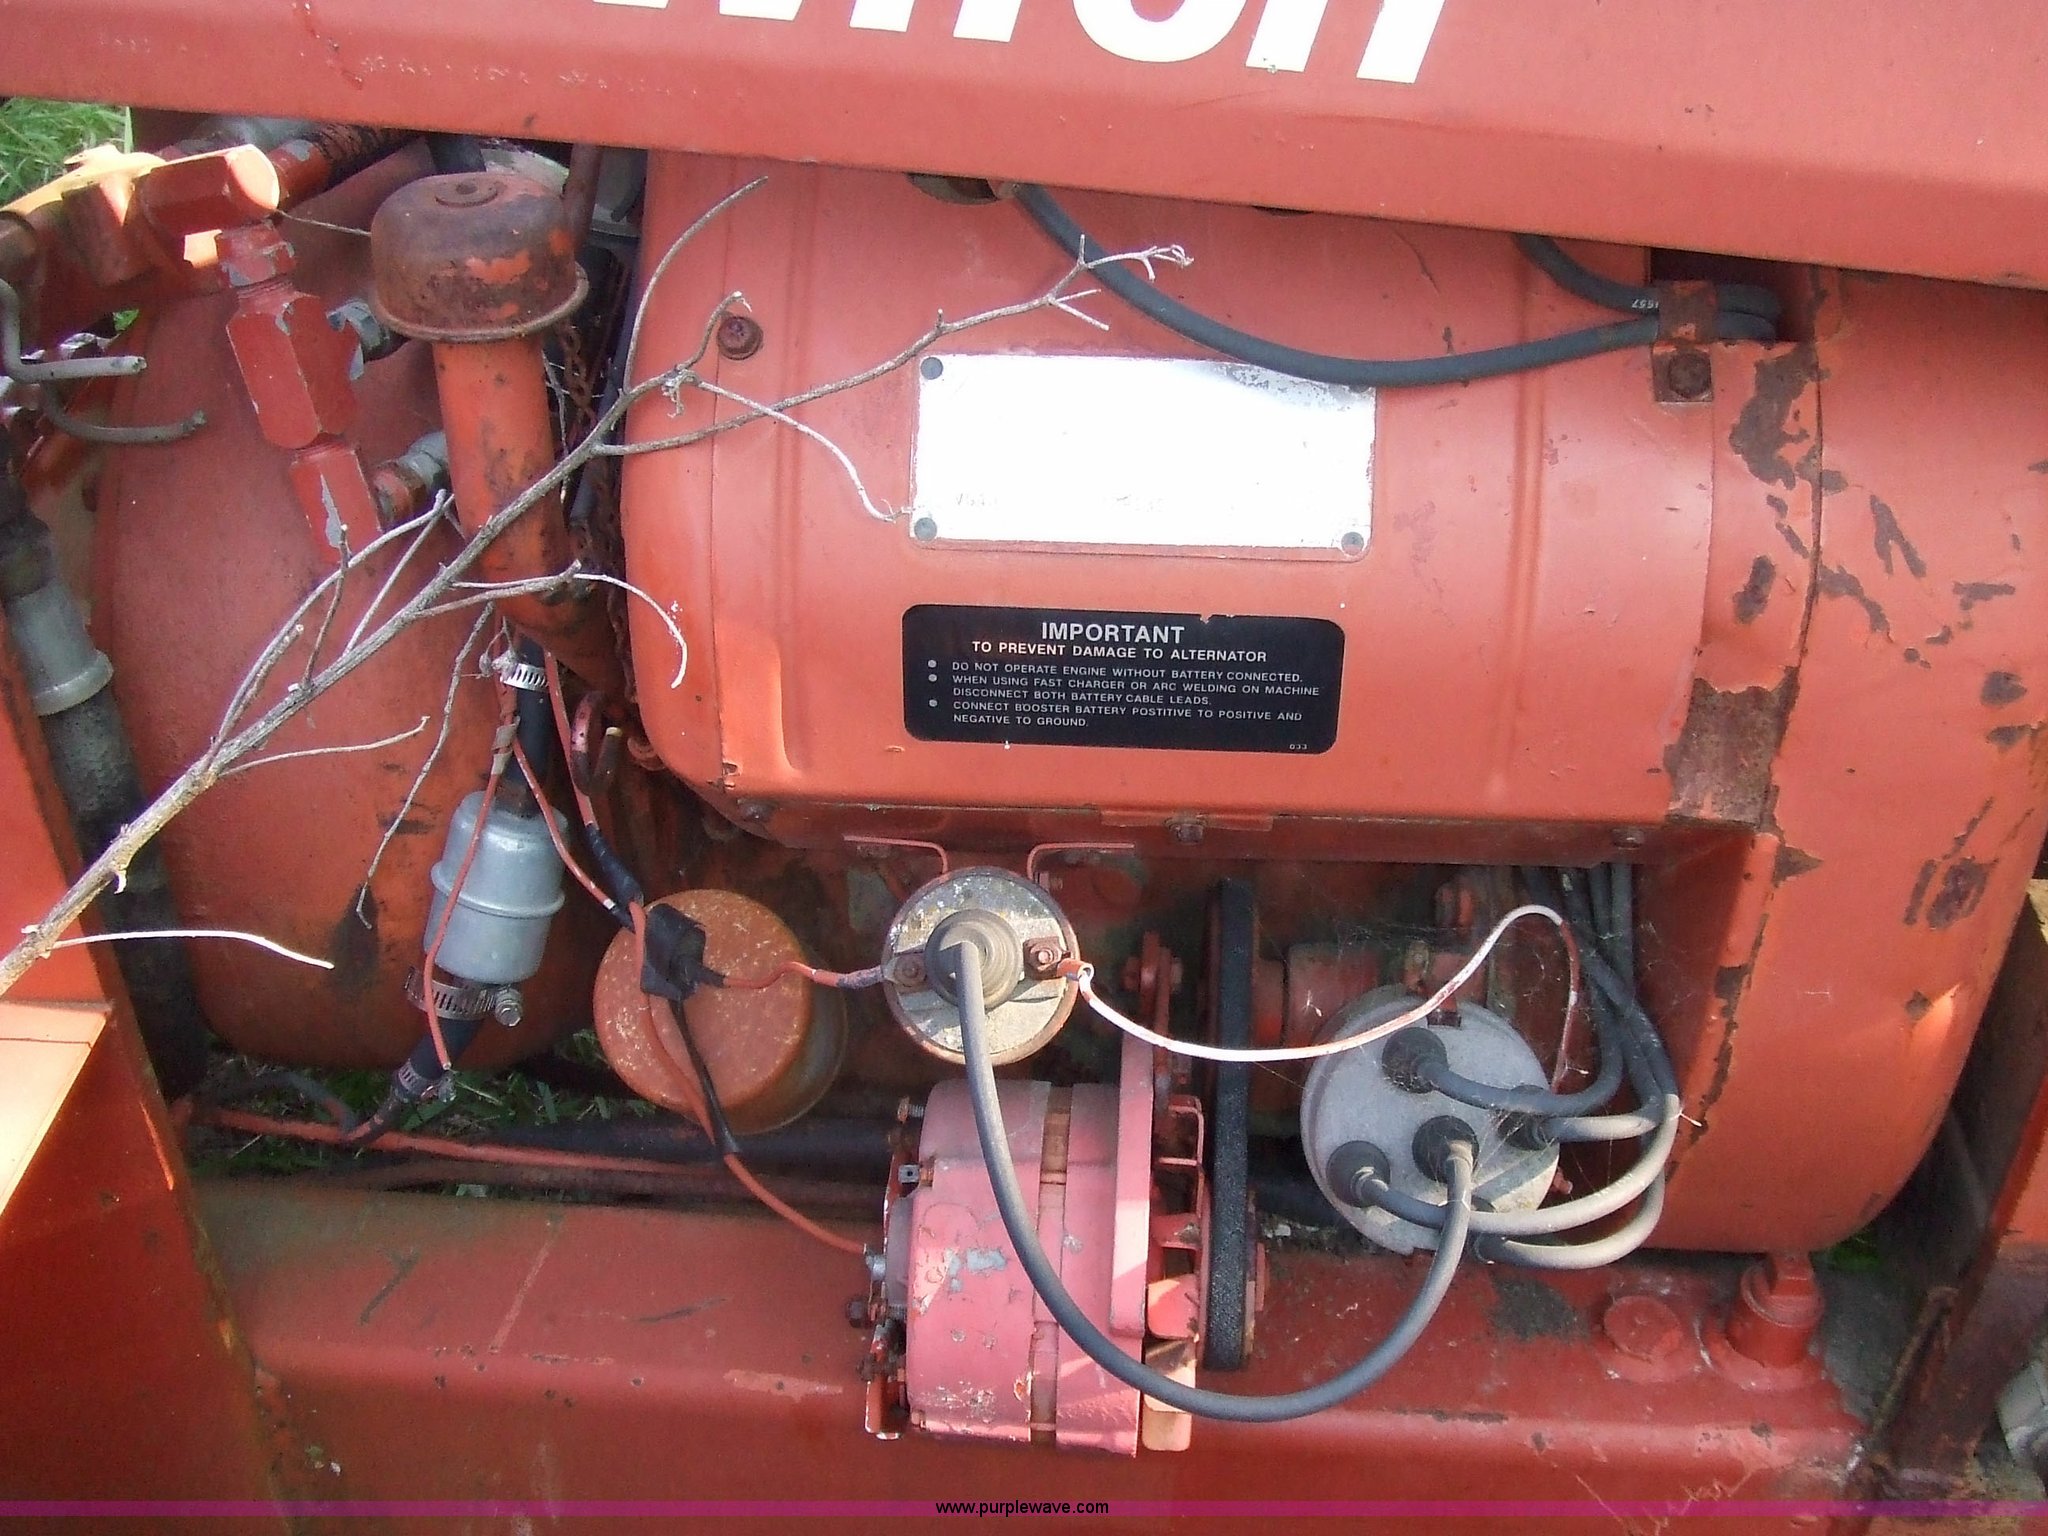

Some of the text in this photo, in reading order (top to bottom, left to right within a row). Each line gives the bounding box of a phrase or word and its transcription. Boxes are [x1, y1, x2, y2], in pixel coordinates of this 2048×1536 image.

[1042, 622, 1185, 644] IMPORTANT
[972, 642, 1267, 662] TO PREVENT DAMAGE TO ALTERNATOR
[952, 662, 1303, 682] DO NOT OPERATE ENGINE WITHOUT BATTERY CONNECTED.
[953, 676, 1319, 696] WHEN USING FAST CHARGER OR ARC WELDING ON MACHINE
[953, 688, 1212, 705] DISCONNECT BOTH BATTERY CABLE LEADS.
[953, 702, 1302, 721] CONNECT BOOSTER BATTERY POSTITIVE TO POSITIVE AND
[953, 715, 1088, 727] NEGATIVE TO GROUND.
